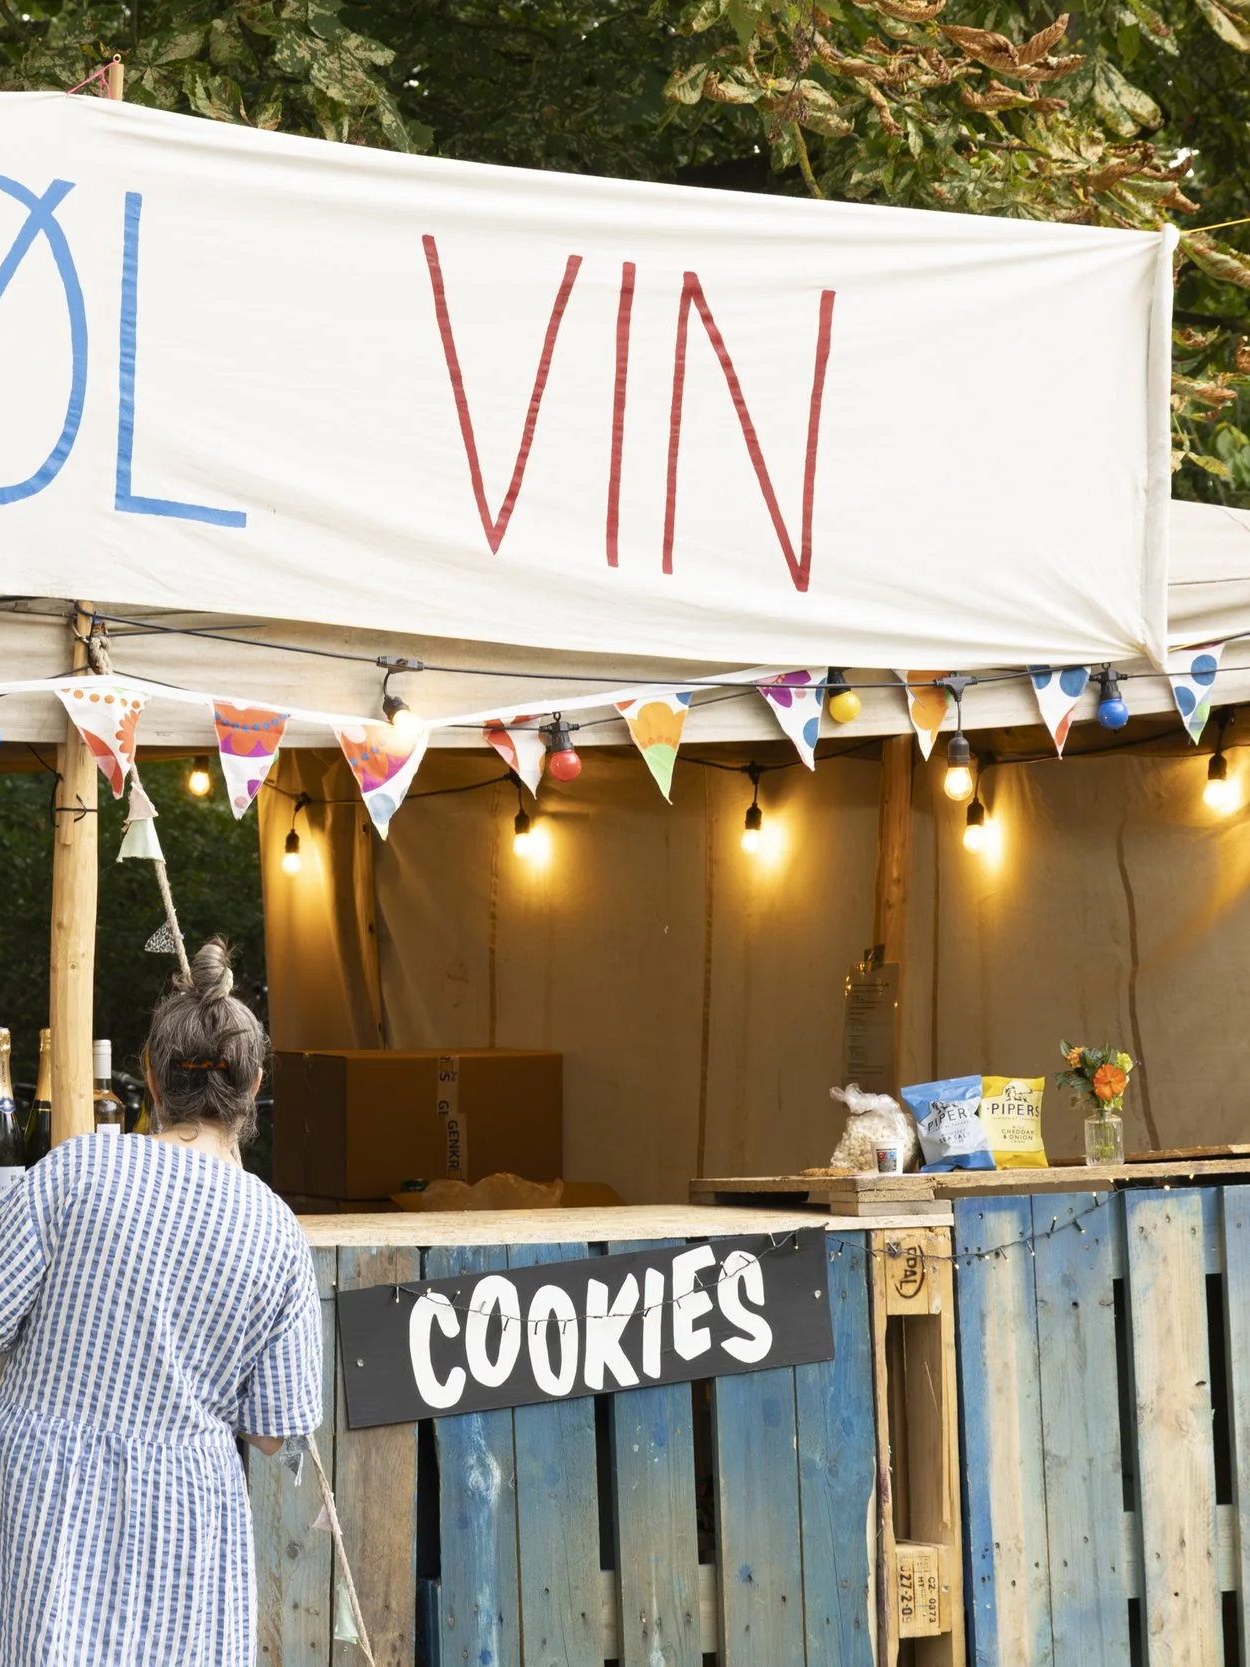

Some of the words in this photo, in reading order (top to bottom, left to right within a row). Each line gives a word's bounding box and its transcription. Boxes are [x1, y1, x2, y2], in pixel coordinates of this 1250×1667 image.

[422, 234, 836, 593] VIN
[927, 1108, 971, 1131] PIPER
[991, 1103, 1040, 1117] PIPERS
[409, 1245, 773, 1409] COOKIES
